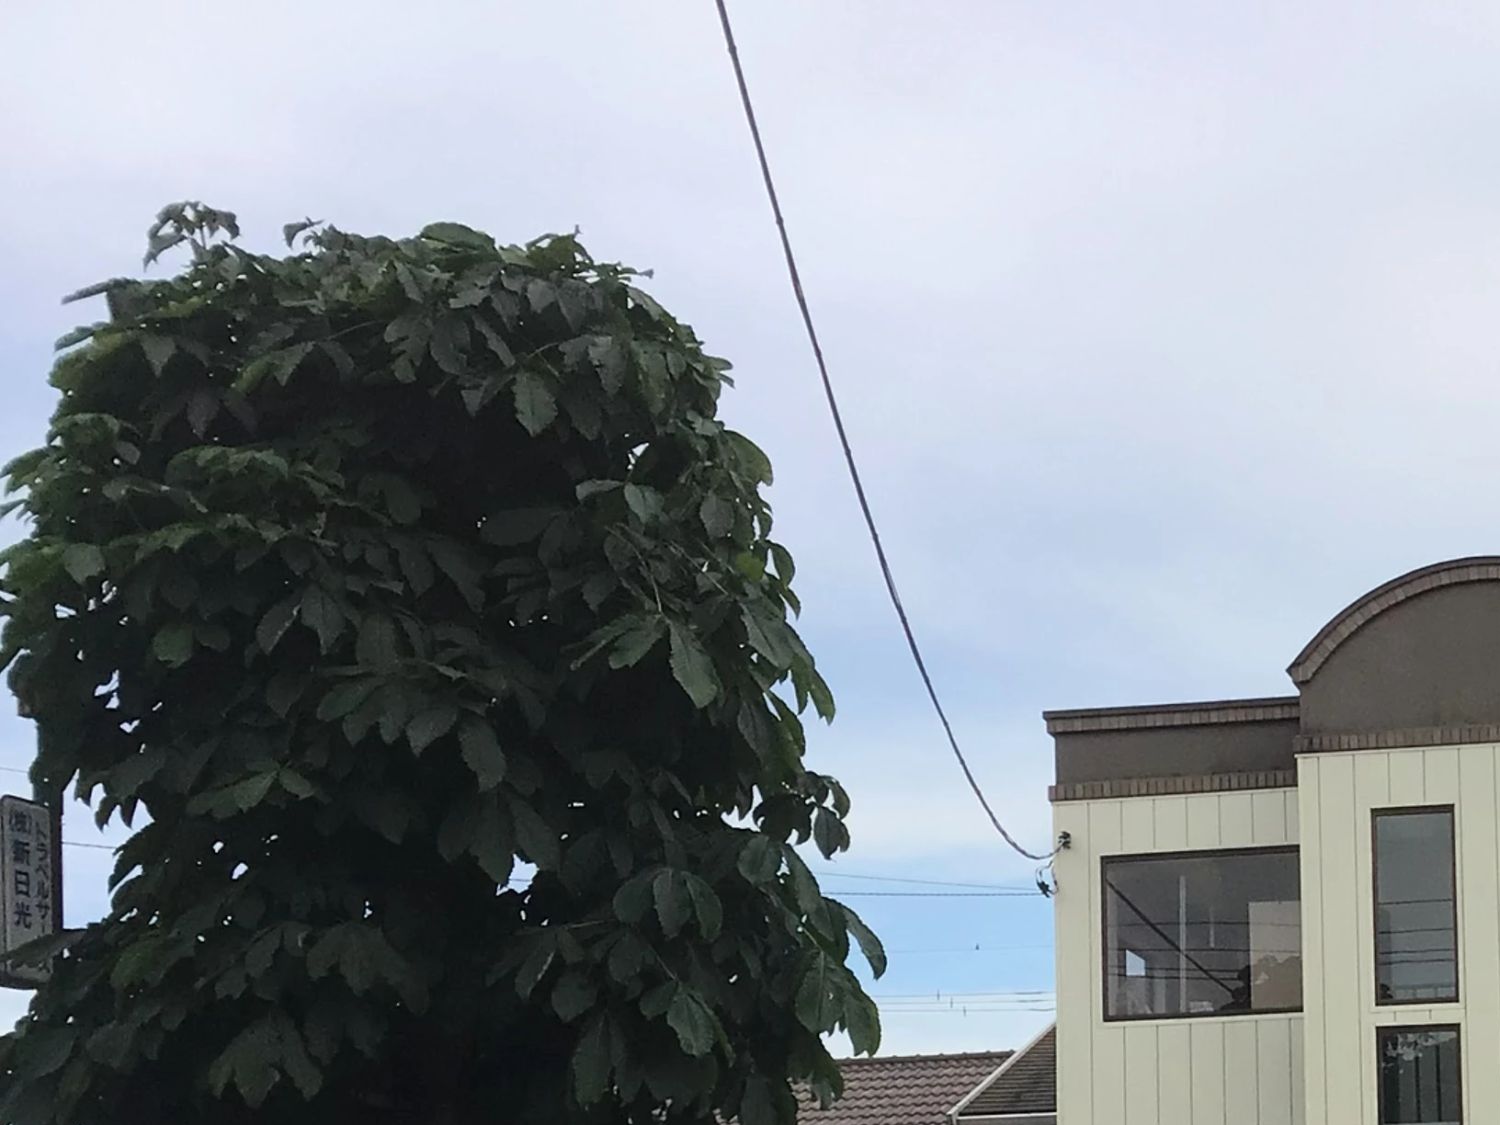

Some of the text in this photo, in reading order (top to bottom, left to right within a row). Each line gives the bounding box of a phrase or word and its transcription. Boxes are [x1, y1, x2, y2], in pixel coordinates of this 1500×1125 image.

[35, 820, 51, 975] トラベルサース
